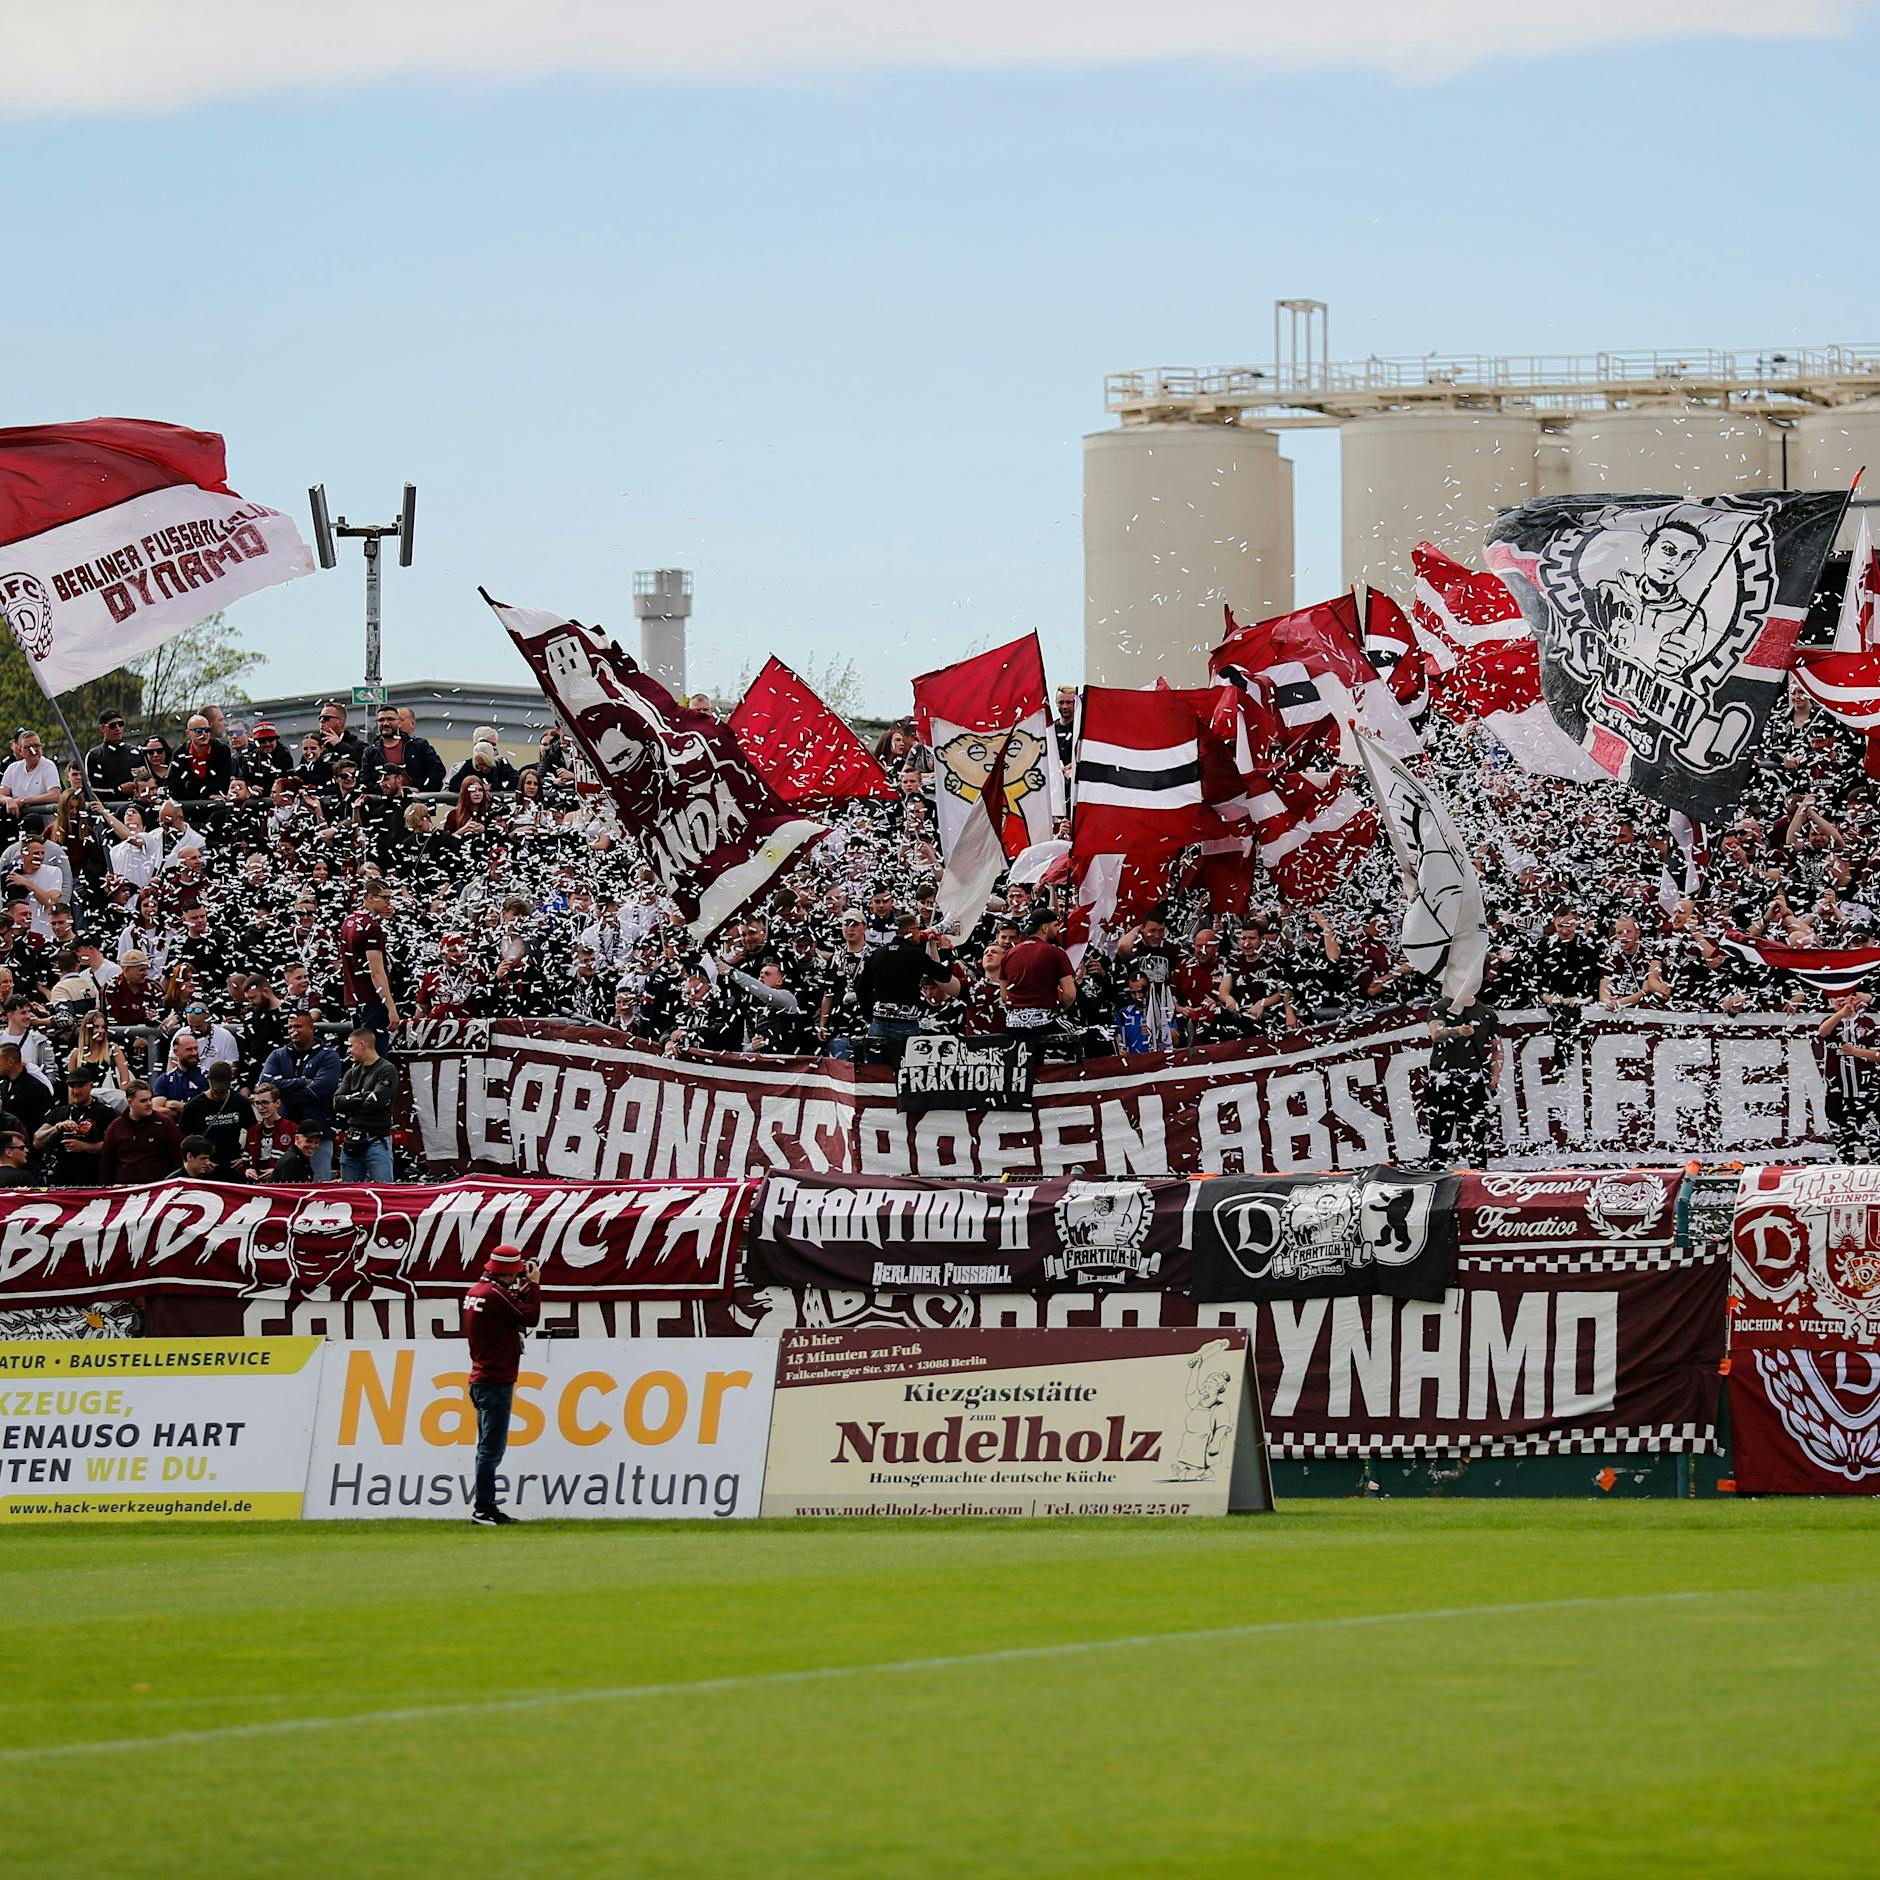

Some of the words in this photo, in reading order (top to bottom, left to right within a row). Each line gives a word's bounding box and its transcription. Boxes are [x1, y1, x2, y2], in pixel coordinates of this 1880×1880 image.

[51, 540, 142, 602] BERLINER
[100, 523, 270, 624] DYNAMO
[897, 1065, 1004, 1094] FRAKTION
[1011, 1066, 1028, 1093] H
[0, 1186, 273, 1282] BANDA
[406, 1186, 730, 1275] INVICTA
[1471, 1206, 1578, 1239] Fanatico
[1734, 1319, 1783, 1332] BOCHUM
[1800, 1320, 1844, 1334] VELTEN
[786, 1354, 804, 1365] 15
[807, 1349, 868, 1364] Minuten
[870, 1348, 890, 1358] zu
[892, 1343, 922, 1357] Fuß
[787, 1336, 809, 1348] Ab
[812, 1334, 843, 1346] hier
[69, 1351, 271, 1368] BAUSTELLENSERVICE
[786, 1366, 862, 1381] Falkenberger
[863, 1364, 882, 1374] Str.
[884, 1363, 905, 1373] 37A
[917, 1359, 950, 1370] 13088
[951, 1355, 987, 1367] Berlin
[337, 1349, 754, 1447] Nascor
[903, 1382, 1098, 1410] Kiezgaststätte
[969, 1413, 997, 1422] zum
[3, 1423, 141, 1449] ENAUSO
[153, 1422, 246, 1447] HART
[830, 1415, 1164, 1464] Nudelholz
[0, 1457, 72, 1483] TEN
[86, 1456, 148, 1482] WIE
[161, 1456, 217, 1481] DU.
[869, 1471, 988, 1487] Hausgemachte
[990, 1471, 1063, 1483] deutsche
[1065, 1470, 1117, 1483] Küche
[329, 1462, 740, 1517] Hausverwaltung
[9, 1499, 252, 1516] www.hack-werkzeughandel.de
[795, 1503, 1023, 1516] www.nudelholz-berlin.com
[1044, 1502, 1074, 1515] Tel.
[1079, 1503, 1109, 1515] 030
[1112, 1503, 1142, 1515] 925
[1146, 1503, 1166, 1515] 25
[1170, 1503, 1191, 1515] 07
